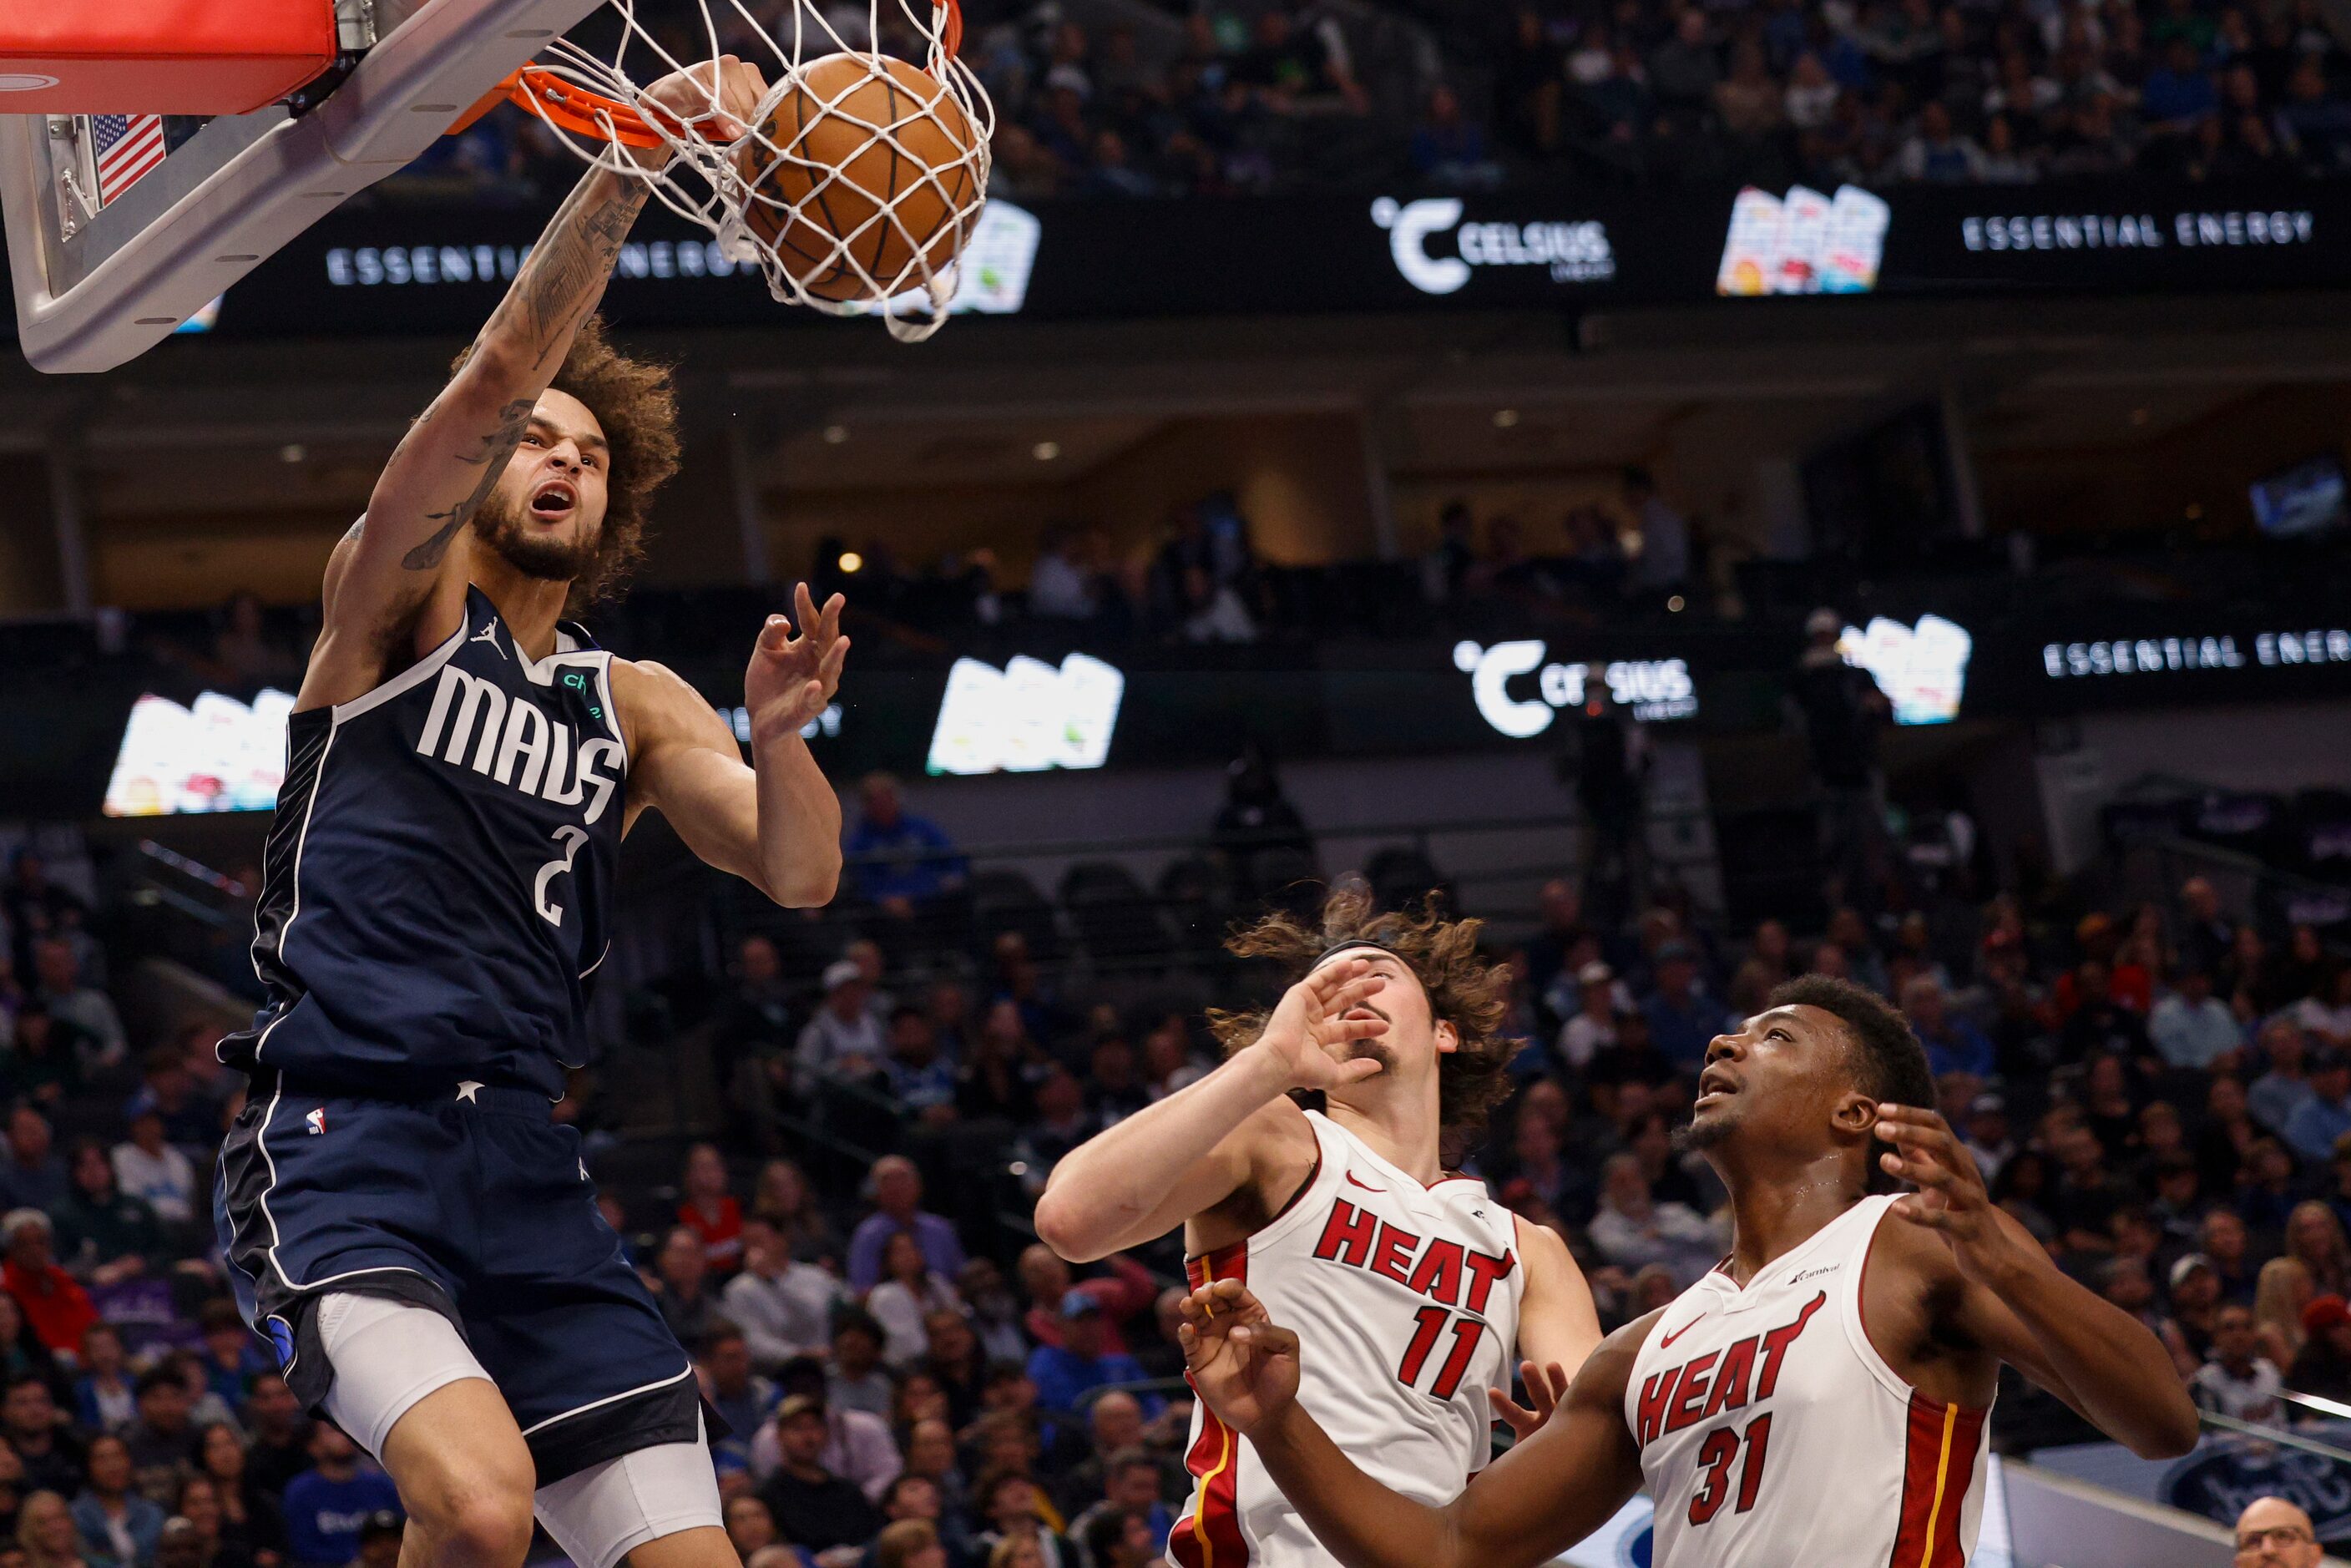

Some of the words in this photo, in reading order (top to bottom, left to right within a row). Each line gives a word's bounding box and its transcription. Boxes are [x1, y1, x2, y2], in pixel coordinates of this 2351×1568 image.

[326, 245, 533, 285] ESSENTI
[1458, 220, 1610, 266] CELSIUS
[1963, 215, 2164, 250] ESSENTIAL
[2175, 211, 2313, 246] ENERGY
[1540, 658, 1694, 707] CESIUS
[2045, 635, 2246, 678] ESSENTIAL
[417, 664, 624, 825] MAVS
[534, 825, 589, 927] 2
[1312, 1196, 1517, 1316] HEAT
[1398, 1305, 1486, 1402] 11
[1637, 1289, 1827, 1454] HEAT
[1687, 1410, 1773, 1527] 31
